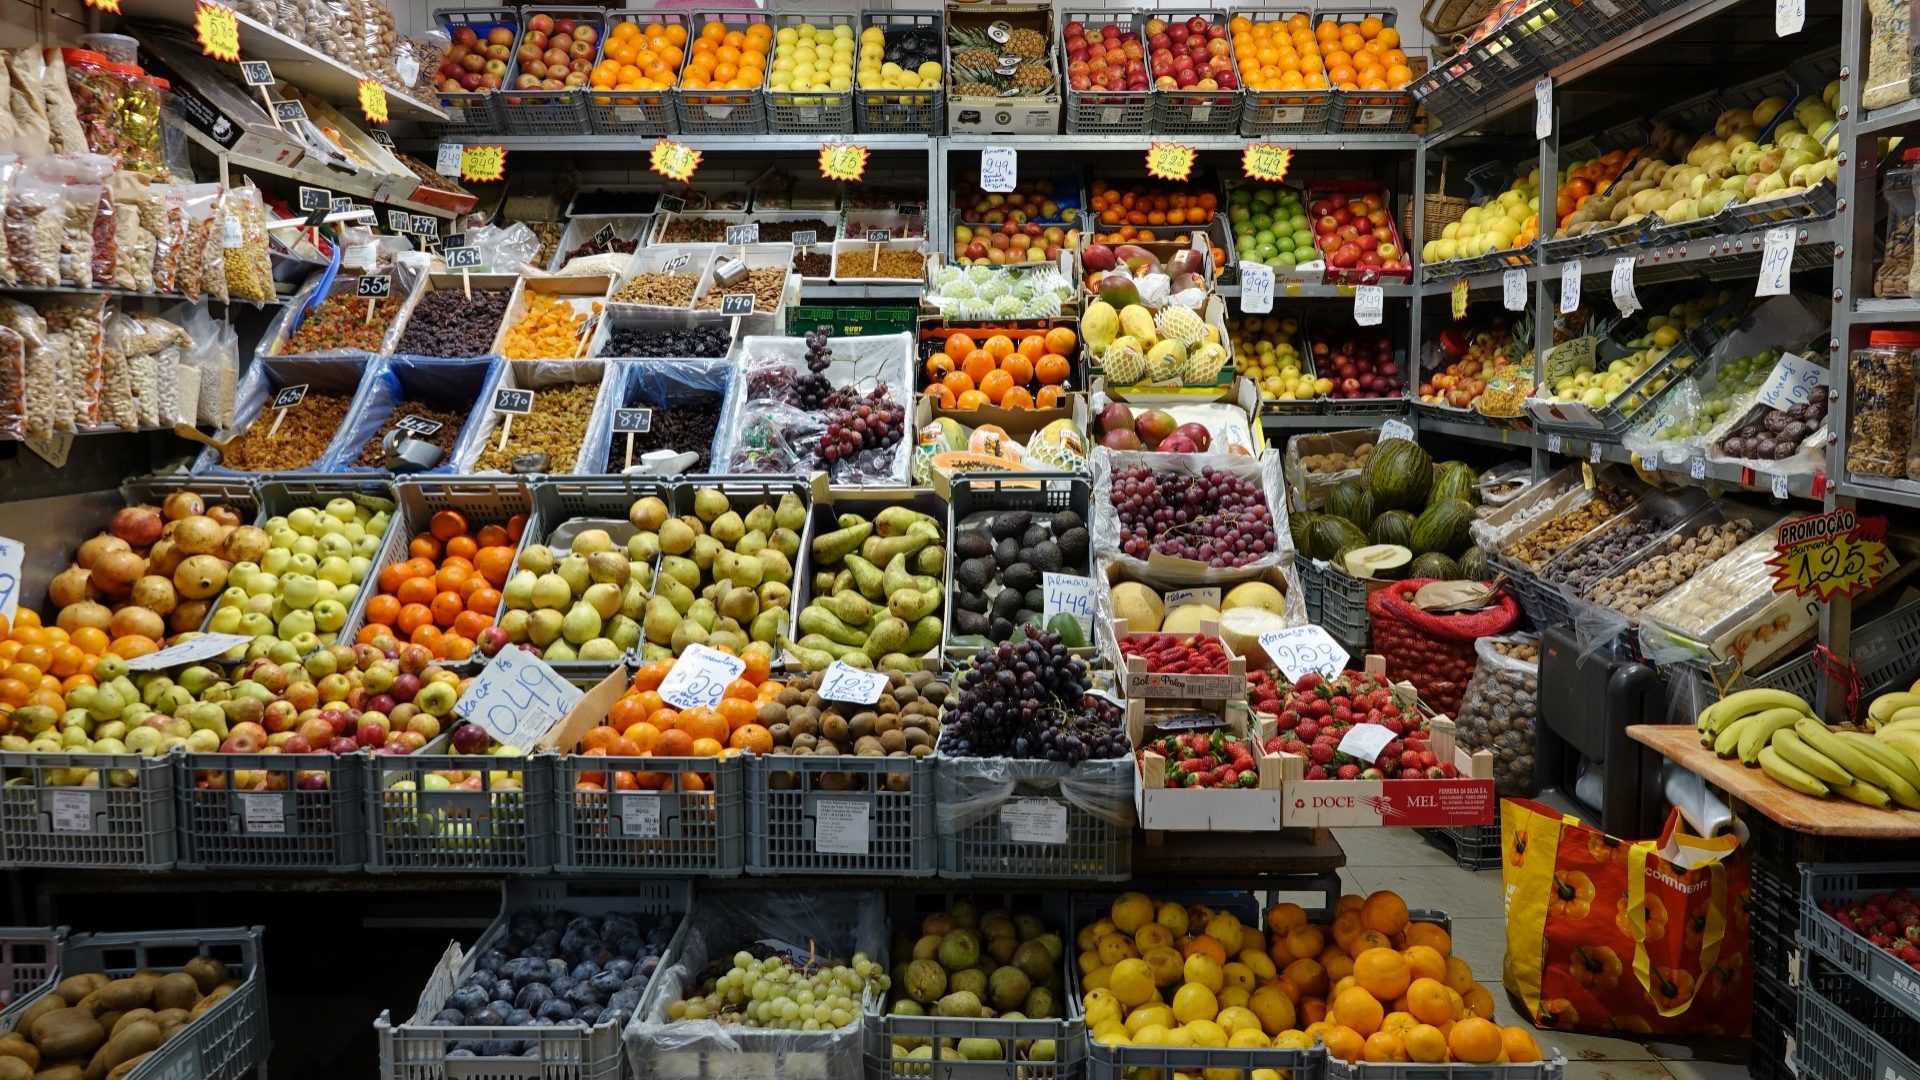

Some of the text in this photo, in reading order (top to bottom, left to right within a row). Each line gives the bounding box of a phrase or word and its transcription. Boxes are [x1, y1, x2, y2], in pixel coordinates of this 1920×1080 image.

[1781, 511, 1854, 545] PROMOÇÃO
[1050, 588, 1088, 616] 449
[1131, 675, 1150, 688] Sol
[1311, 796, 1355, 809] DOCE
[1406, 796, 1439, 808] MEL
